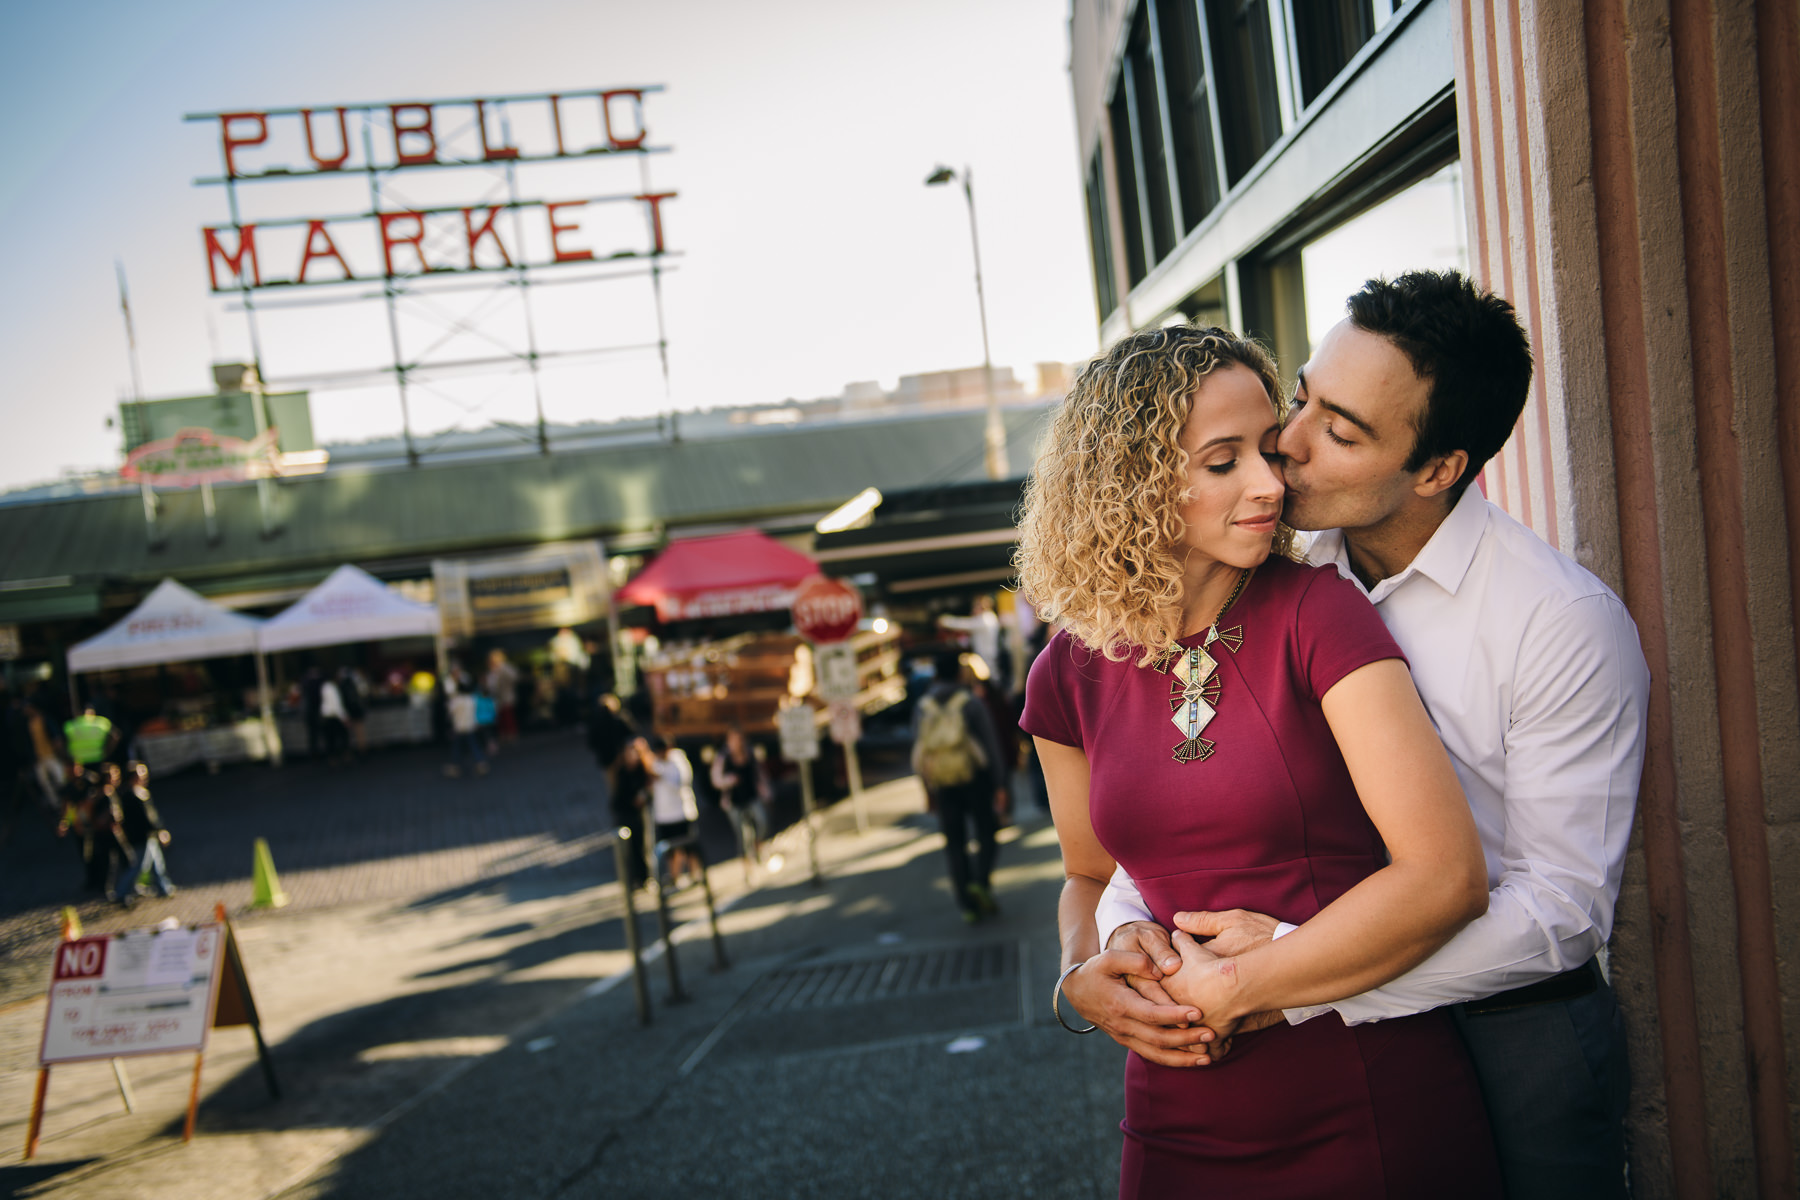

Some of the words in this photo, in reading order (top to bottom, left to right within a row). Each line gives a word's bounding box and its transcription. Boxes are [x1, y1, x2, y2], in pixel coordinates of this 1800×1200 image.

[219, 89, 646, 178] PUBLIC
[203, 192, 678, 291] MARKET
[795, 594, 857, 630] STOP
[60, 940, 101, 977] NO
